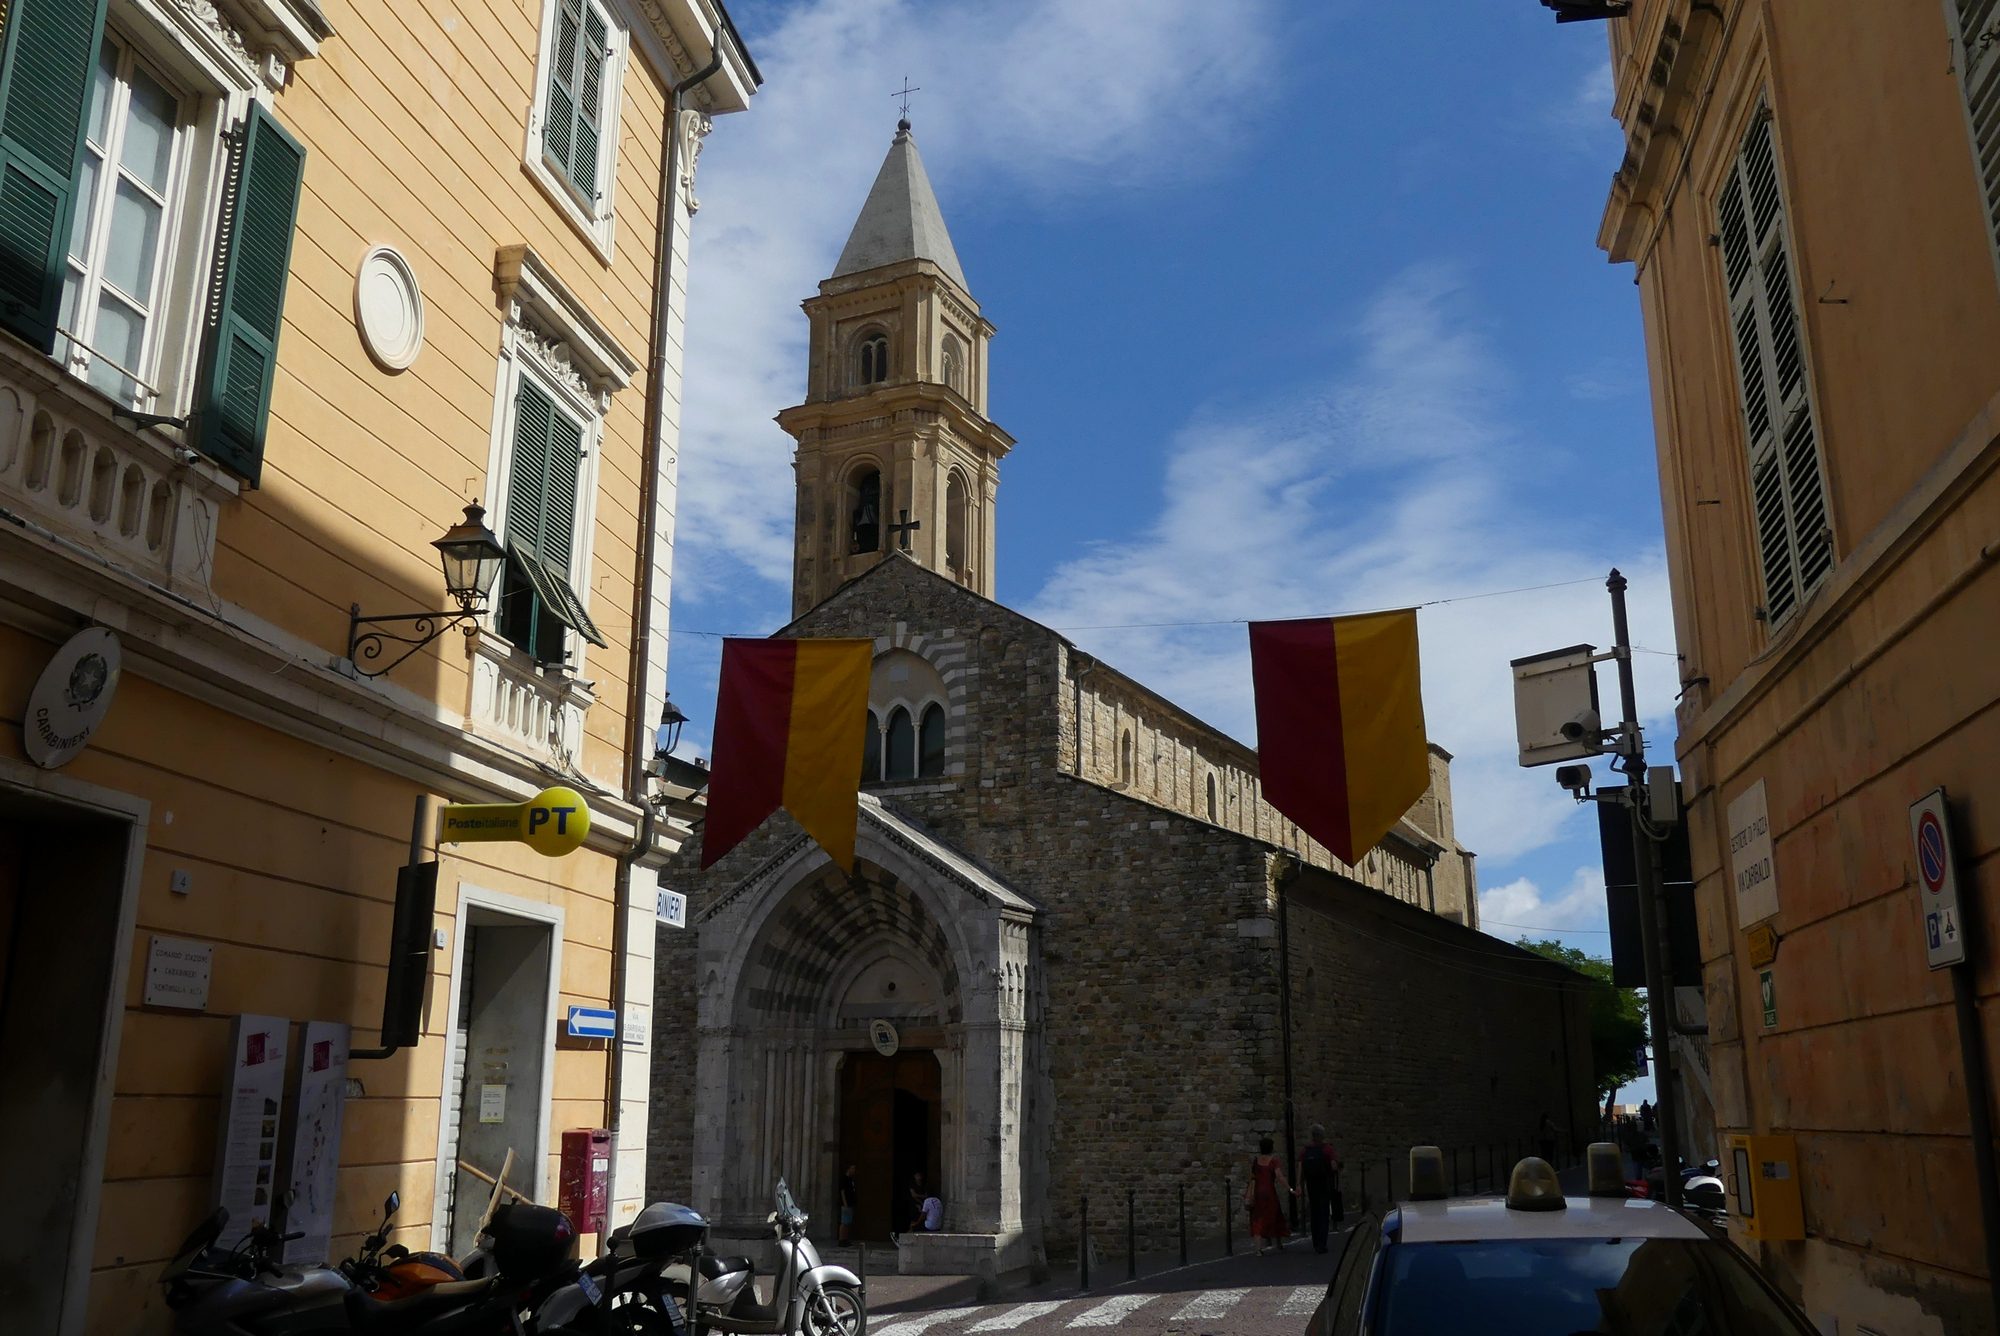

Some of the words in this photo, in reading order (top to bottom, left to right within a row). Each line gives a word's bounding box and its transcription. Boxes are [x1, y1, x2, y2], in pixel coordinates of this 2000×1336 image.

[36, 708, 90, 749] CARABINIERI
[528, 807, 577, 835] PT
[1753, 816, 1768, 836] PIAZZA
[180, 876, 186, 888] 4
[1929, 919, 1937, 946] P
